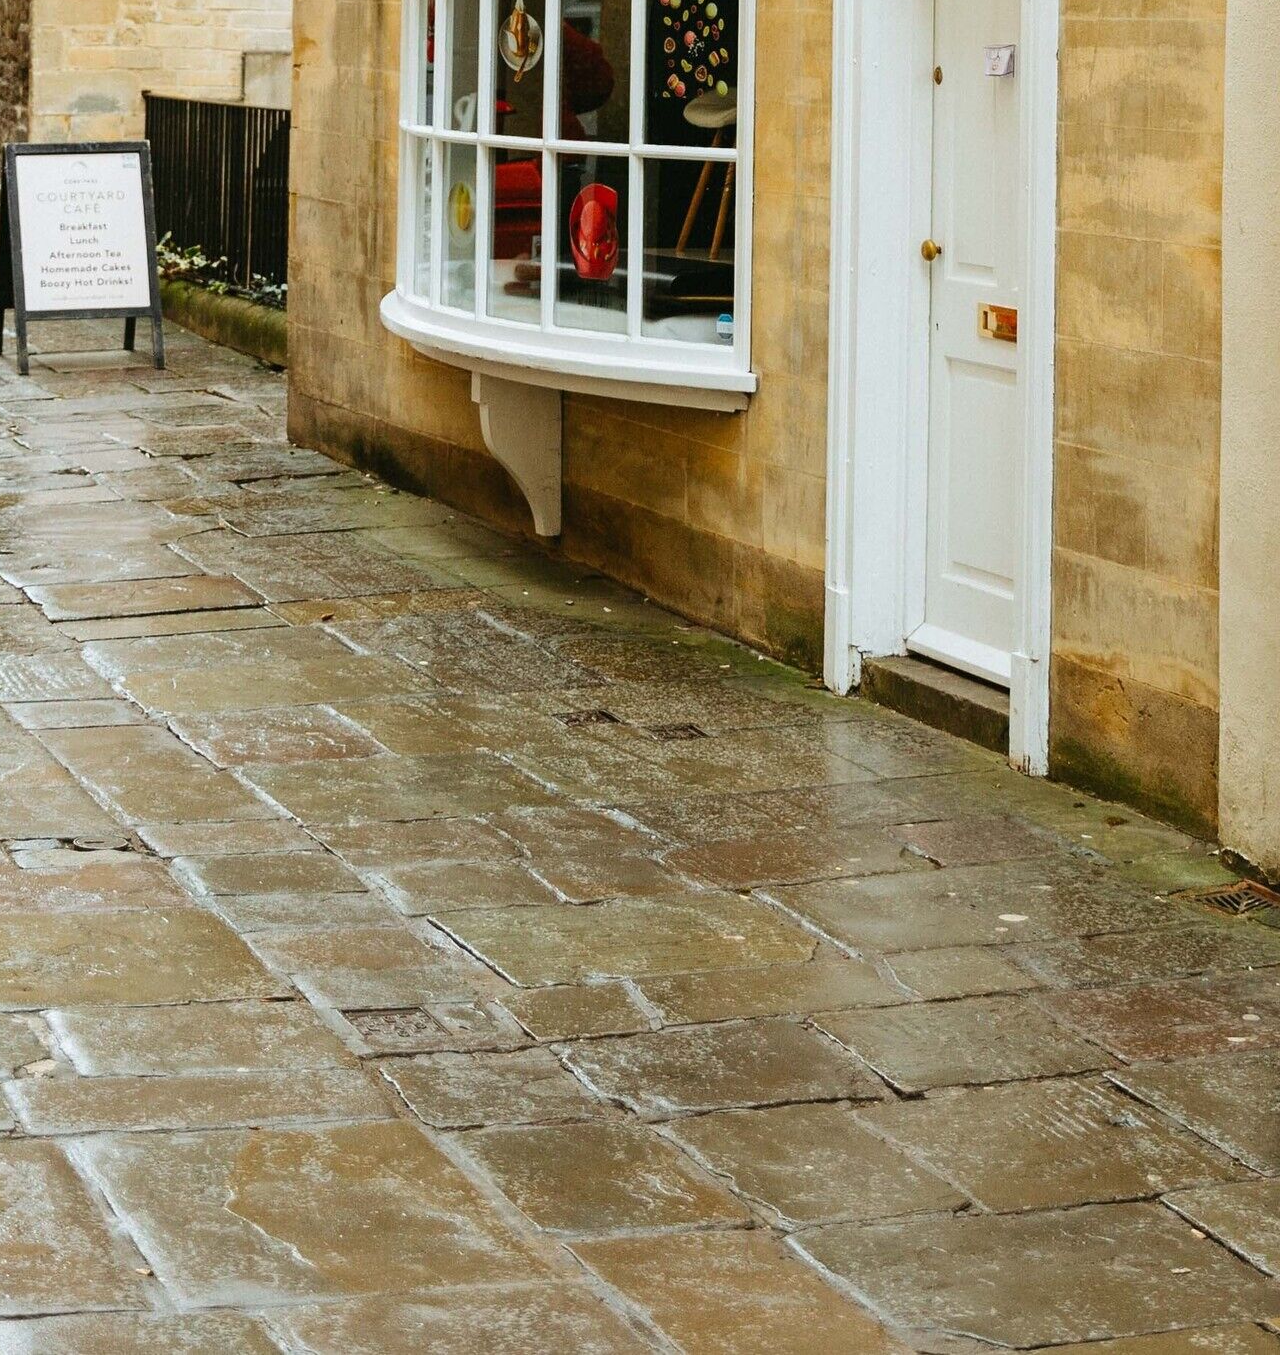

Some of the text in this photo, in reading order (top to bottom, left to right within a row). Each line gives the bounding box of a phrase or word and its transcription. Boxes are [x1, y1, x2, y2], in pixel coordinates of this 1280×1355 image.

[37, 190, 125, 202] COURTYARD
[59, 223, 109, 231] Breakfast
[70, 236, 99, 245] Lunch
[49, 249, 122, 260] Afternoon Tea
[41, 263, 132, 274] Homemade Cakes
[40, 277, 133, 290] Boozy Hot Drinks!
